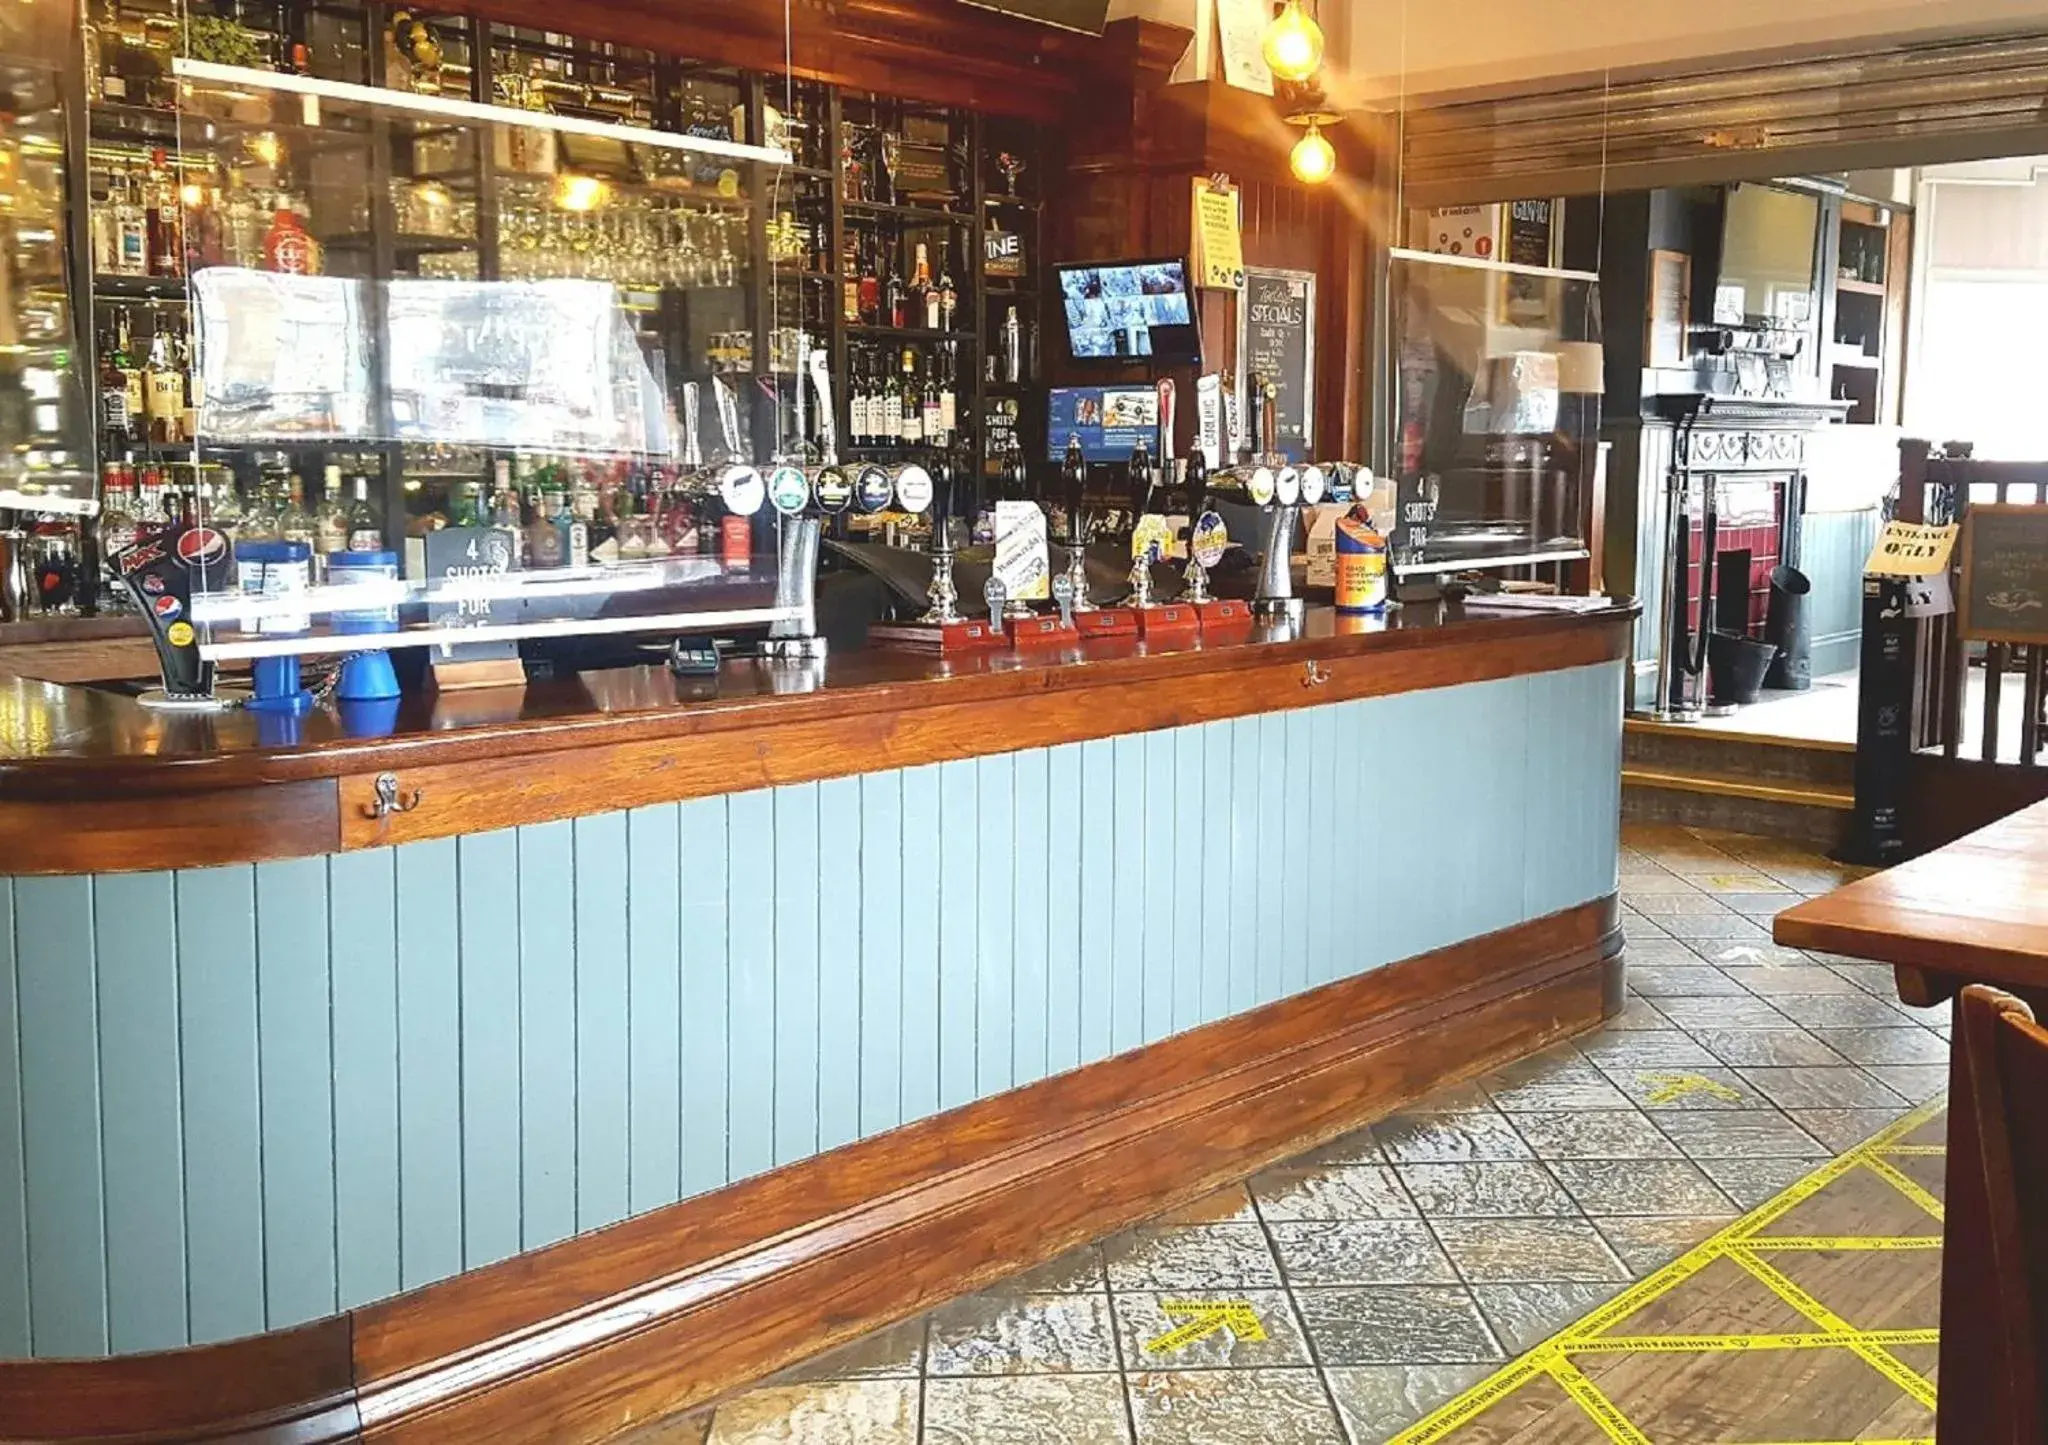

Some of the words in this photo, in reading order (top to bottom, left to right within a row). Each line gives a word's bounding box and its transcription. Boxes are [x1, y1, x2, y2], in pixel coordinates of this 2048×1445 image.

[1251, 304, 1302, 324] SPECIALS
[985, 414, 1016, 426] SHOTS
[1203, 399, 1217, 447] CARLING
[1404, 502, 1436, 522] SHOTS
[466, 538, 479, 560] 4
[1885, 542, 1939, 557] ONLY
